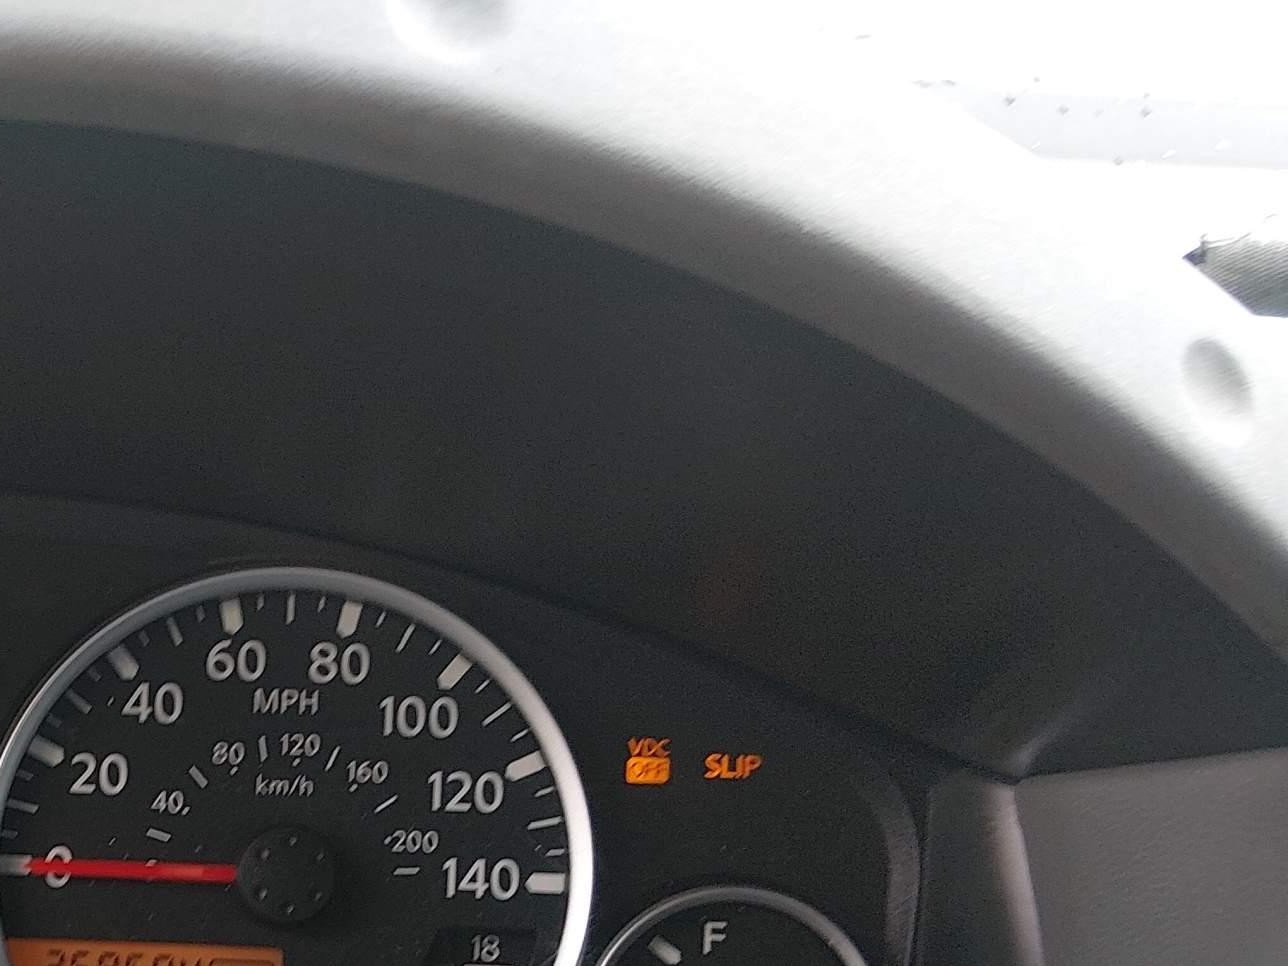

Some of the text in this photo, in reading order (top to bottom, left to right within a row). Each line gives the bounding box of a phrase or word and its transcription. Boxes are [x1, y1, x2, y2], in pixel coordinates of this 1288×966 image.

[207, 639, 267, 681] 60
[308, 641, 371, 685] 80
[121, 681, 184, 725] 40
[252, 688, 320, 715] MPH
[379, 695, 458, 738] 100
[212, 741, 245, 766] 80
[280, 732, 320, 759] 120
[626, 737, 672, 757] VDC
[69, 752, 129, 796] 20
[346, 760, 389, 784] 160
[703, 752, 762, 780] SLIP
[255, 774, 315, 798] km/h
[428, 770, 505, 814] 120
[150, 791, 185, 815] 40
[389, 830, 439, 854] 200
[44, 844, 74, 889] 0
[441, 857, 520, 900] 140
[471, 934, 501, 962] 18
[702, 920, 728, 954] F
